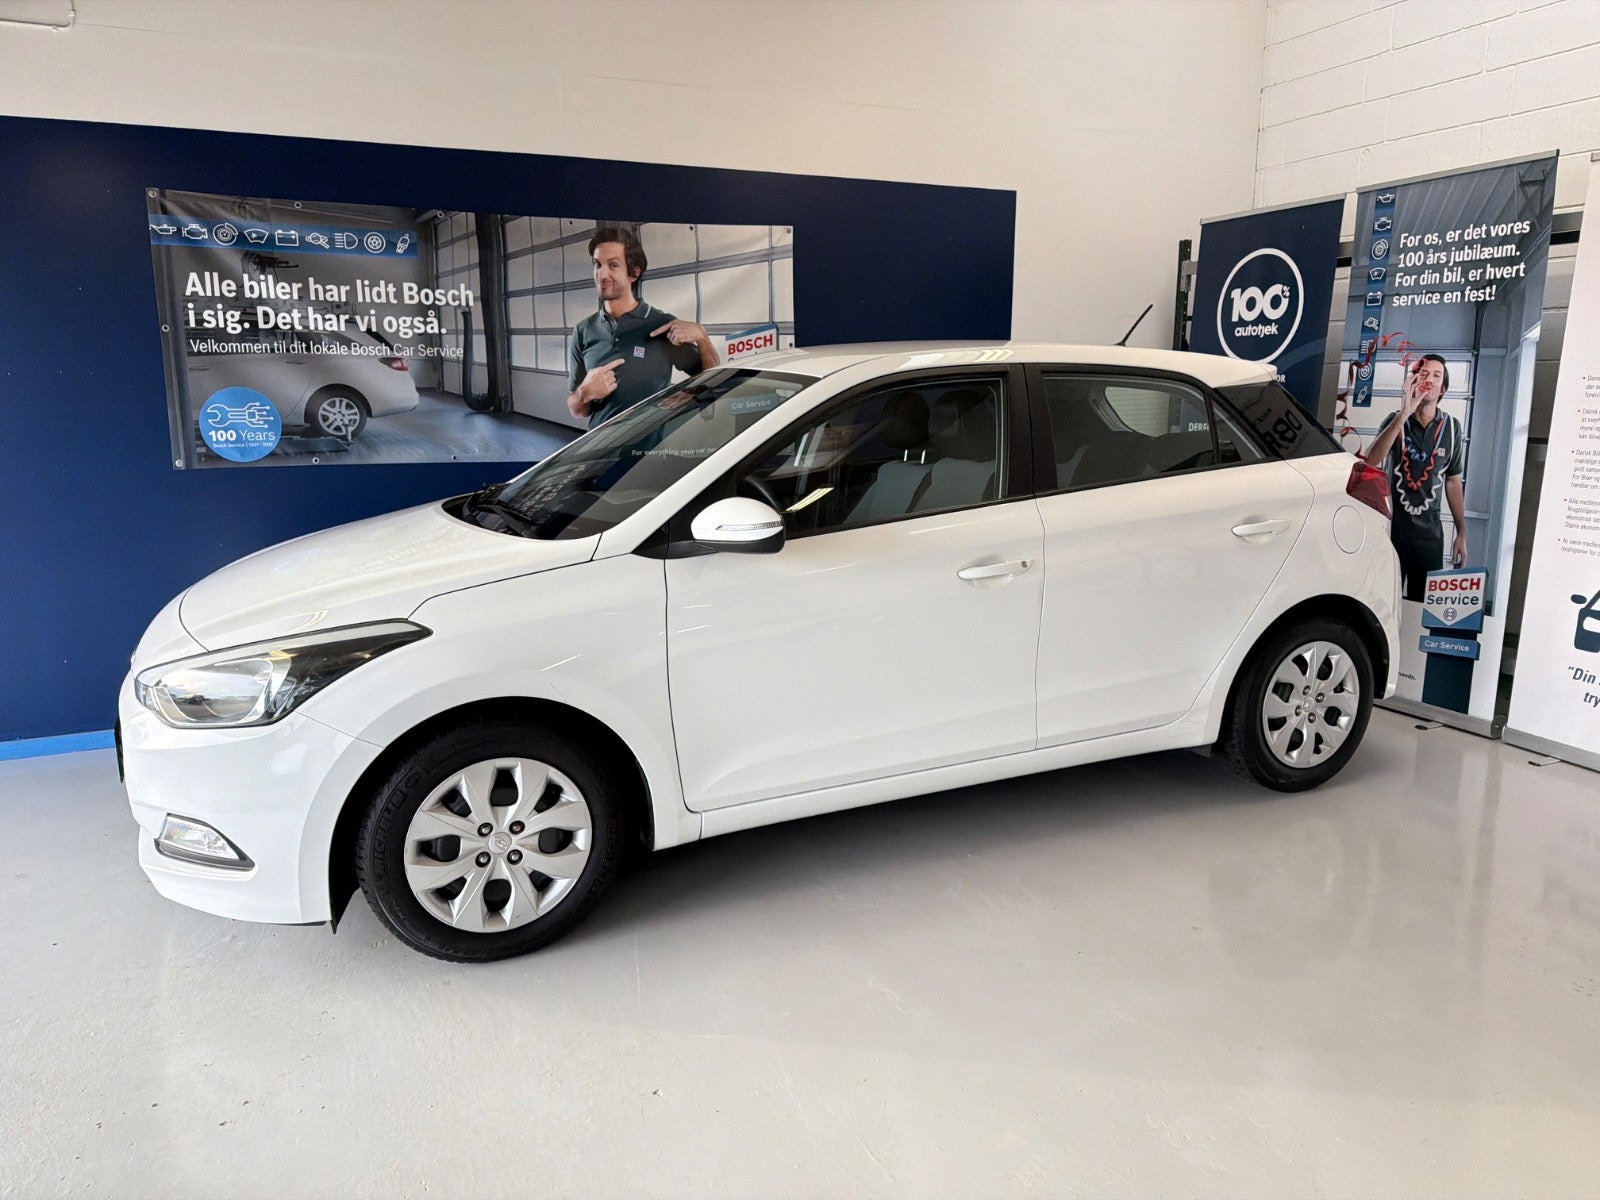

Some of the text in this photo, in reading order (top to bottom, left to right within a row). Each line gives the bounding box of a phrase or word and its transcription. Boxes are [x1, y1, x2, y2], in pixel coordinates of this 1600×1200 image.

[1400, 220, 1531, 248] For os, er det vores
[1398, 243, 1520, 267] 100 års jubilæum.
[1395, 262, 1526, 287] For din bil, er hvert
[185, 271, 474, 307] Alle biler har lidt Bosch
[1392, 285, 1497, 307] service en fest!
[187, 302, 447, 339] i sig. Det har vi også.
[1234, 323, 1278, 338] autotjek
[190, 338, 464, 358] Velkommen til dit lokale Bosch Car Service
[728, 334, 773, 355] BOSCH
[745, 398, 772, 409] Service
[208, 429, 276, 442] 100 Years
[1428, 577, 1482, 592] BOSCH
[1426, 593, 1480, 606] Service
[1424, 639, 1471, 653] Car Service
